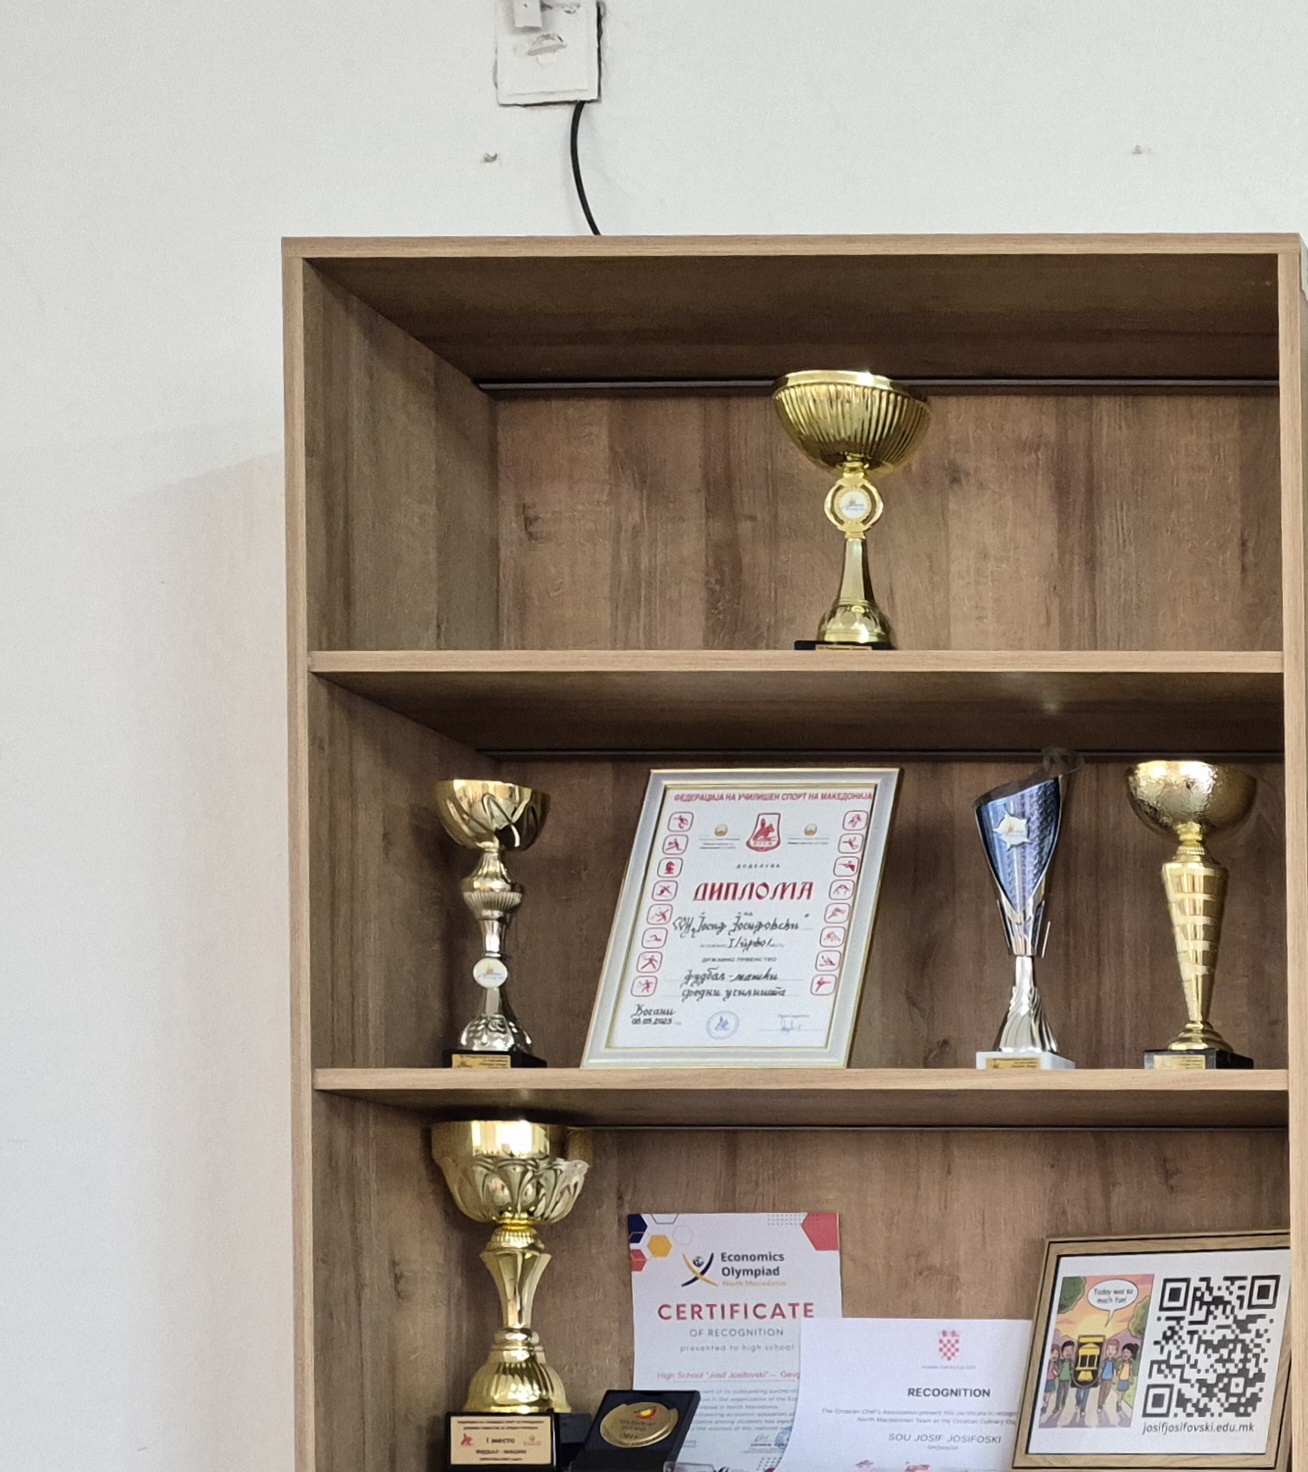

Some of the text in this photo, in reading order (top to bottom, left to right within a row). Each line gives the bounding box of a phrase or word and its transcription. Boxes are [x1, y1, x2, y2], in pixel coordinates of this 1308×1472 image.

[674, 792, 874, 801] ФЕДЕРАЦИЈА НА УЧИЛИШЕН СПОРТ НА МАКЕДОНИЈА
[693, 881, 813, 901] ДИПЛОМА
[721, 1252, 785, 1263] Economics
[721, 1267, 780, 1279] Olympiad
[658, 1303, 815, 1320] CERTIFICATE
[690, 1329, 784, 1337] OF RECOGNITION
[742, 1344, 761, 1352] high
[907, 1388, 991, 1398] RECOGNITION
[1142, 1422, 1255, 1435] josifjosifovski.edu.mk
[888, 1433, 1002, 1444] SOU JOSIF JOSIFOSKI
